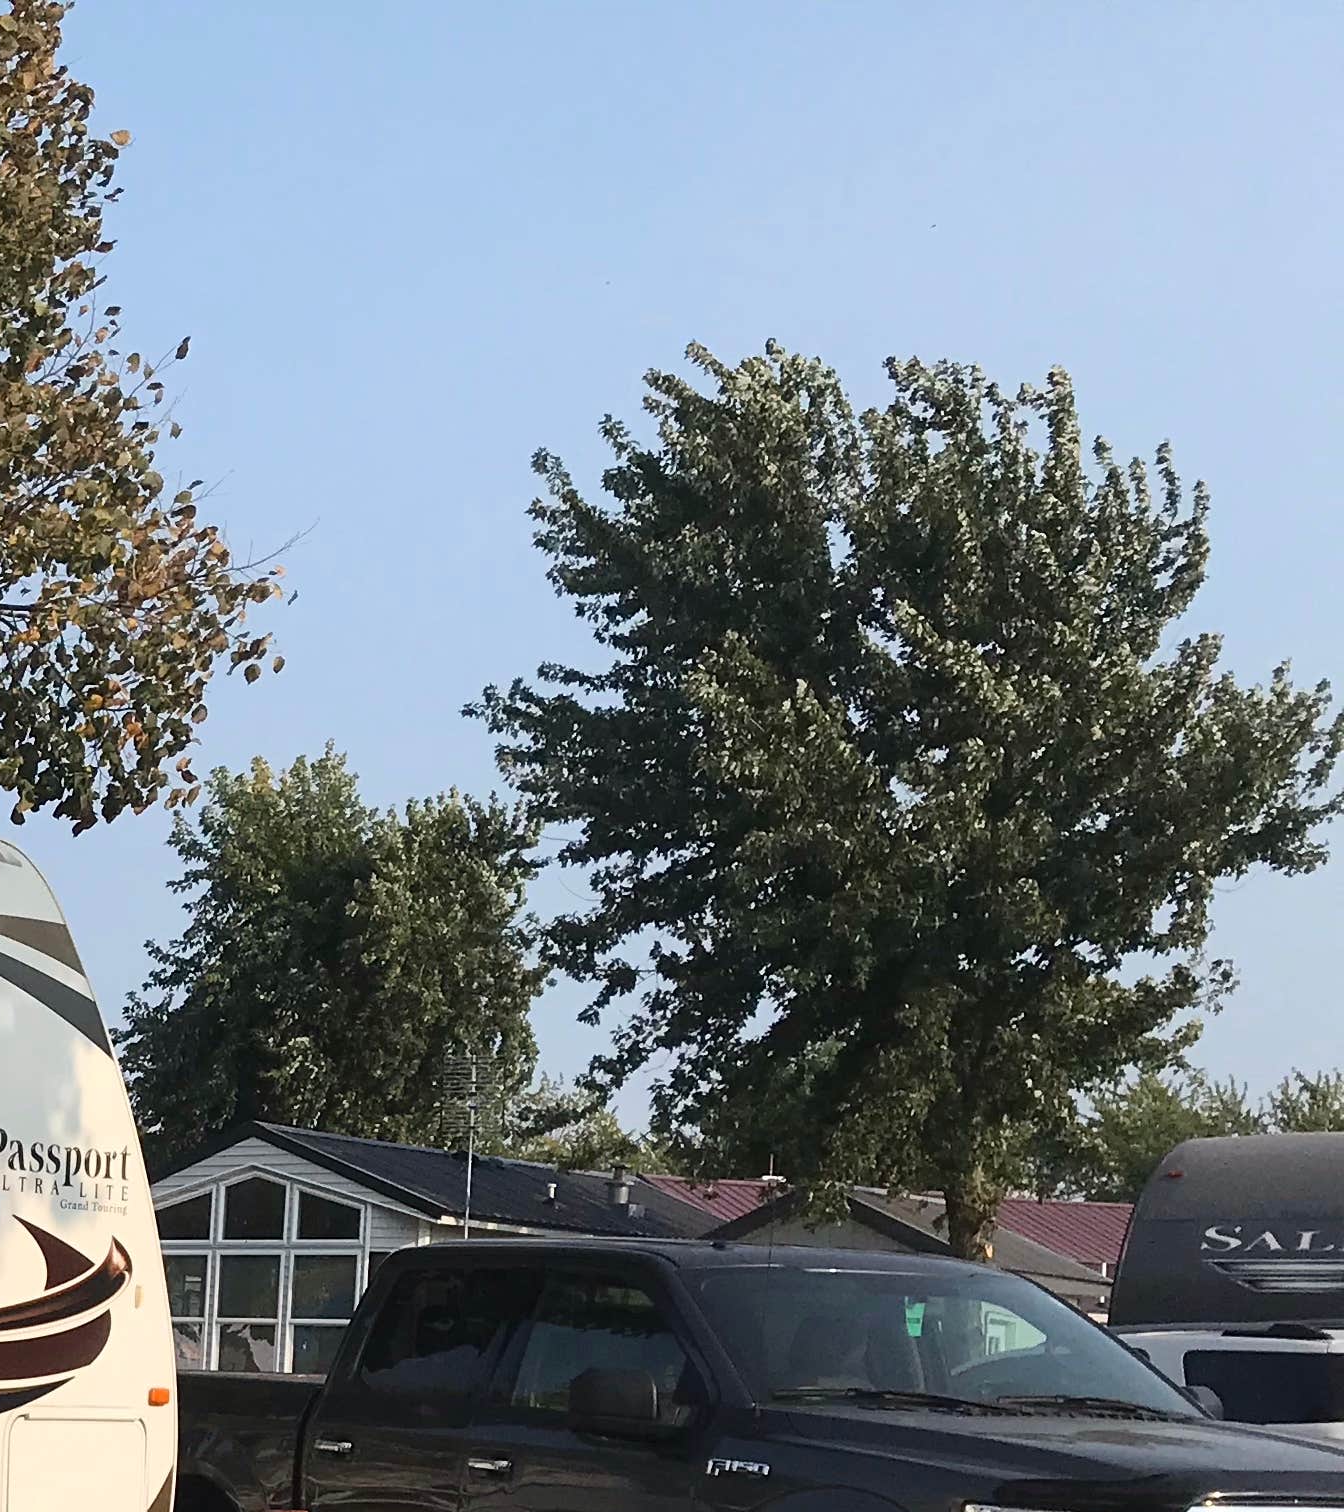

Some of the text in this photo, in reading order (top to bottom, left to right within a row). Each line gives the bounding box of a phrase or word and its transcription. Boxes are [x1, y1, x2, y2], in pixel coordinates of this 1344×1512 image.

[79, 1182, 129, 1202] LITE
[60, 1199, 128, 1217] Grand Touring
[1200, 1225, 1344, 1252] SAL
